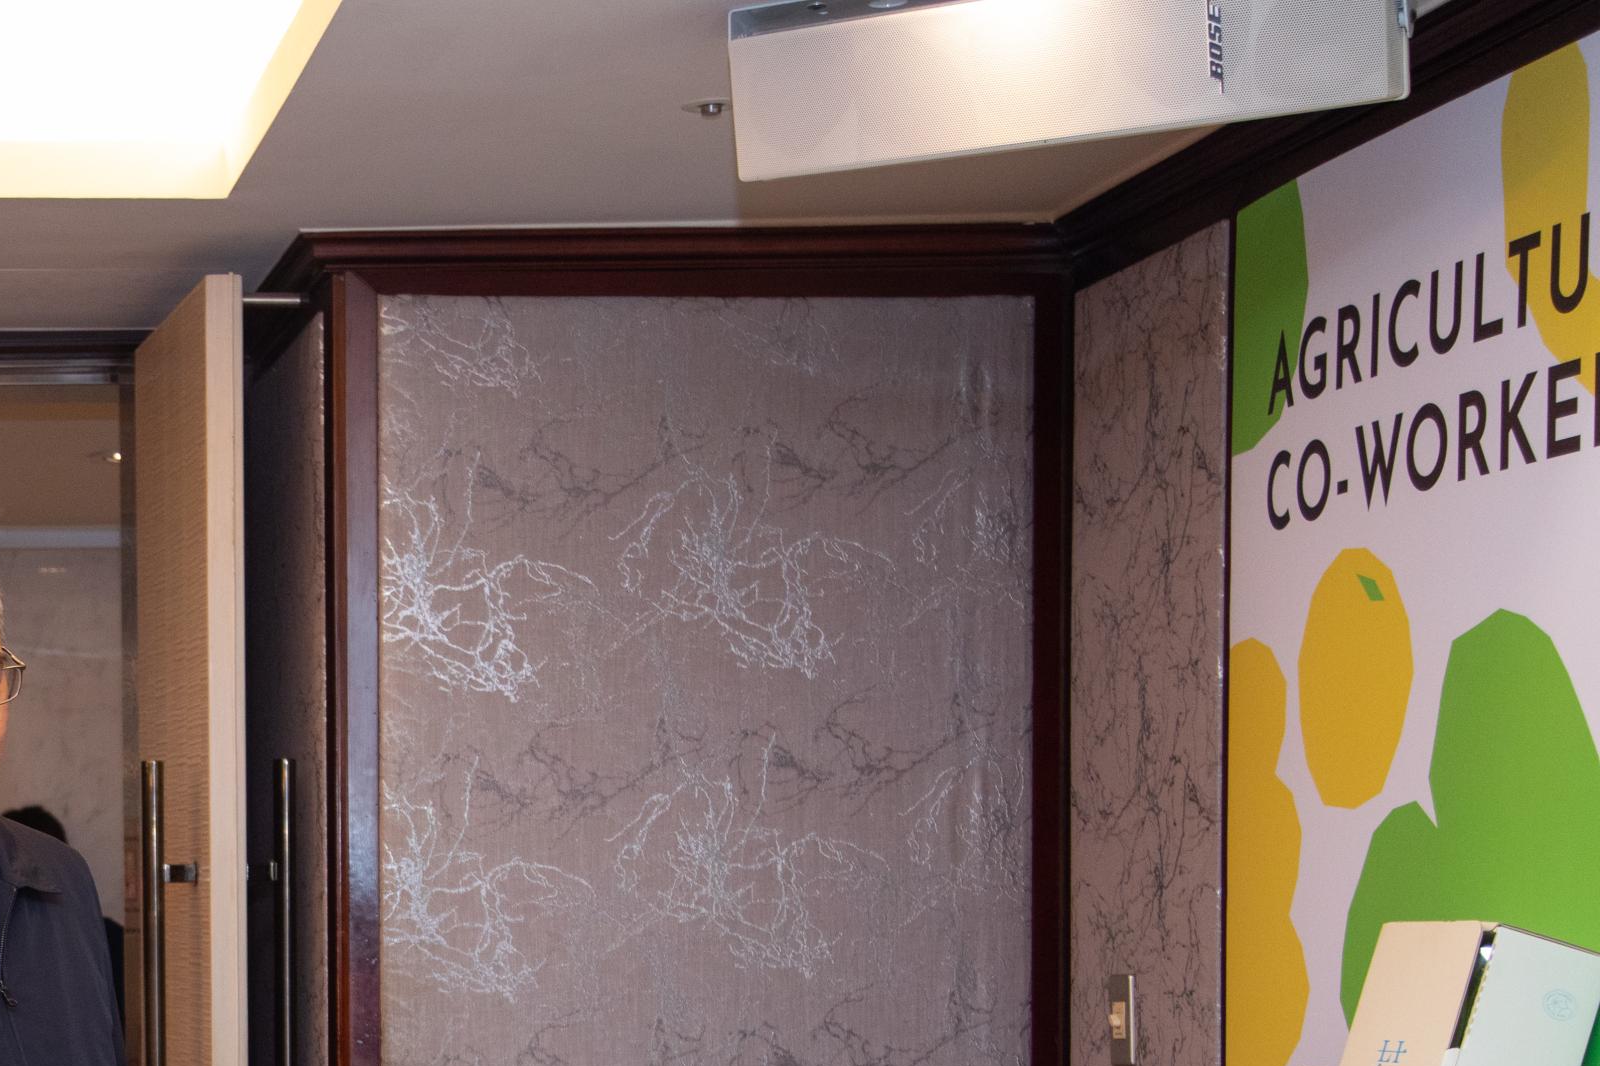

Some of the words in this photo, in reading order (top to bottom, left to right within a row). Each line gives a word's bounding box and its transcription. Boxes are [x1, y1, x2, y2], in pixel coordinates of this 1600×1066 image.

[1207, 0, 1224, 93] BOSE
[1268, 212, 1591, 415] AGRICULTU
[1268, 352, 1600, 530] CO-WORKE
